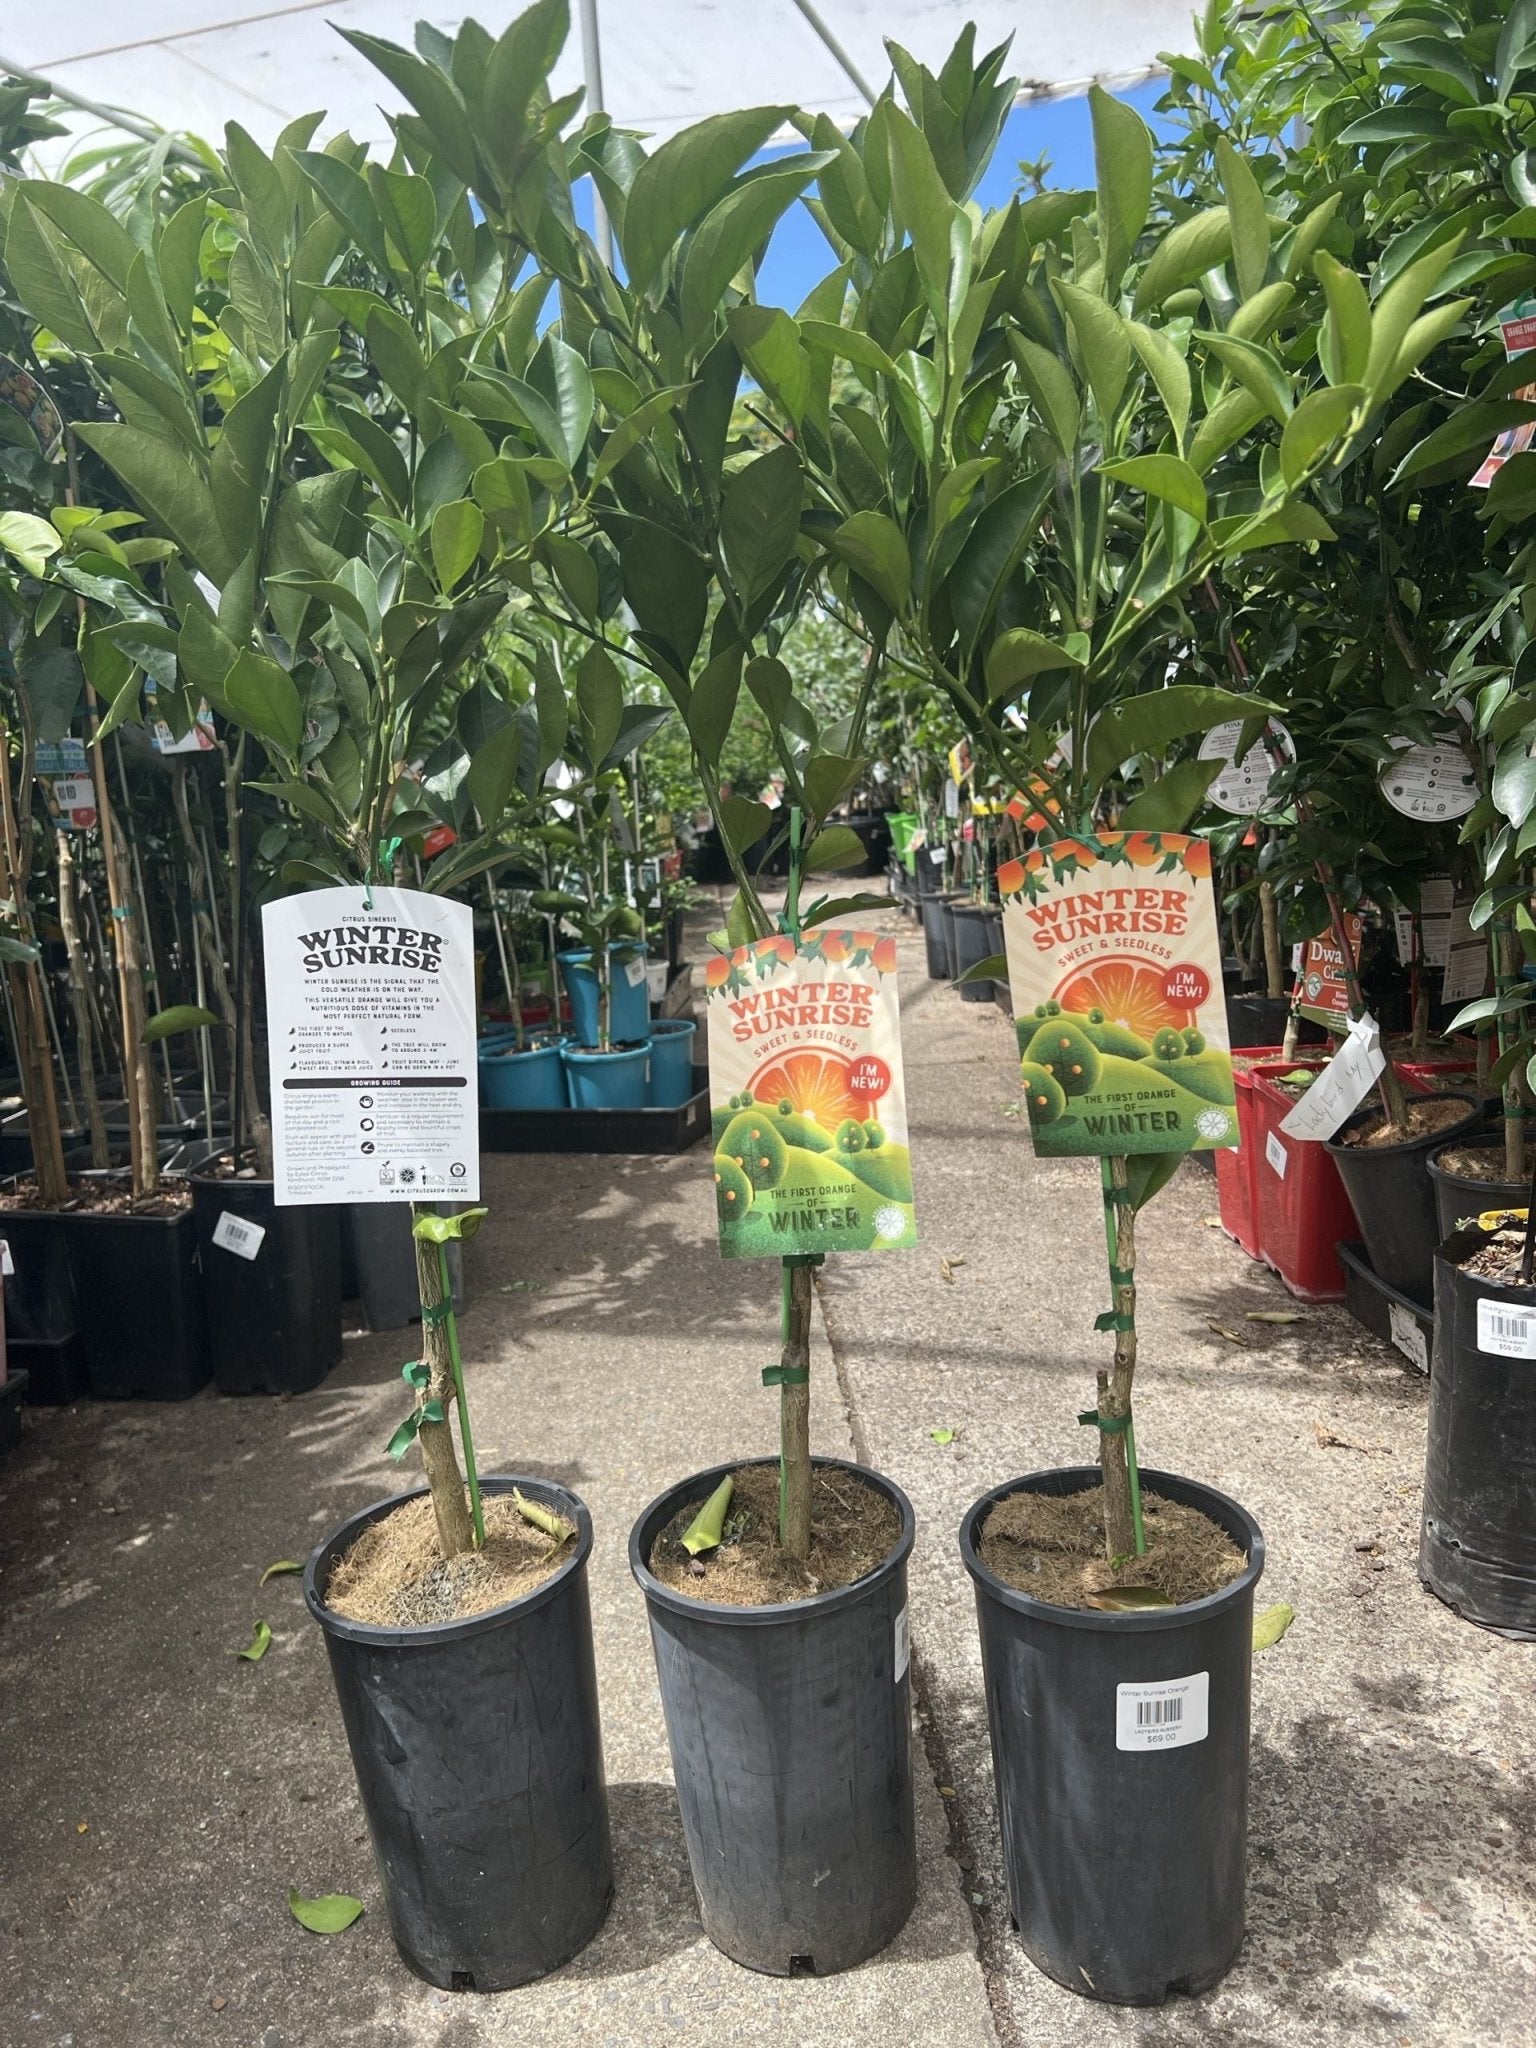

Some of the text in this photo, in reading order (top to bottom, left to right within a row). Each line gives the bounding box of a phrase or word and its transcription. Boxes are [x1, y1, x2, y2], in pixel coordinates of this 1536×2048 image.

[1026, 888, 1188, 928] WINTER
[297, 926, 443, 954] WINTER
[1033, 911, 1189, 952] SUNRISE
[303, 946, 442, 974] SUNRISE
[1057, 937, 1173, 968] SWEET & SEEDLESS
[1310, 941, 1345, 965] Dwa
[1176, 971, 1195, 986] I'M
[727, 982, 873, 1021] WINTER
[1167, 983, 1203, 999] NEW!
[732, 1004, 873, 1043] SUNRISE
[753, 1029, 858, 1059] SWEET & SEEDLESS
[859, 1063, 877, 1077] I'M
[382, 1079, 401, 1087] GUIDE
[850, 1075, 885, 1091] NEW!
[1083, 1088, 1176, 1104] THE FIRST ORANGE
[1124, 1102, 1137, 1112] OF
[1083, 1110, 1183, 1138] WINTER
[769, 1183, 857, 1200] THE FIRST ORANGE
[806, 1197, 818, 1208] OF
[768, 1207, 861, 1234] WINTER
[1147, 1733, 1176, 1743] $69.00
